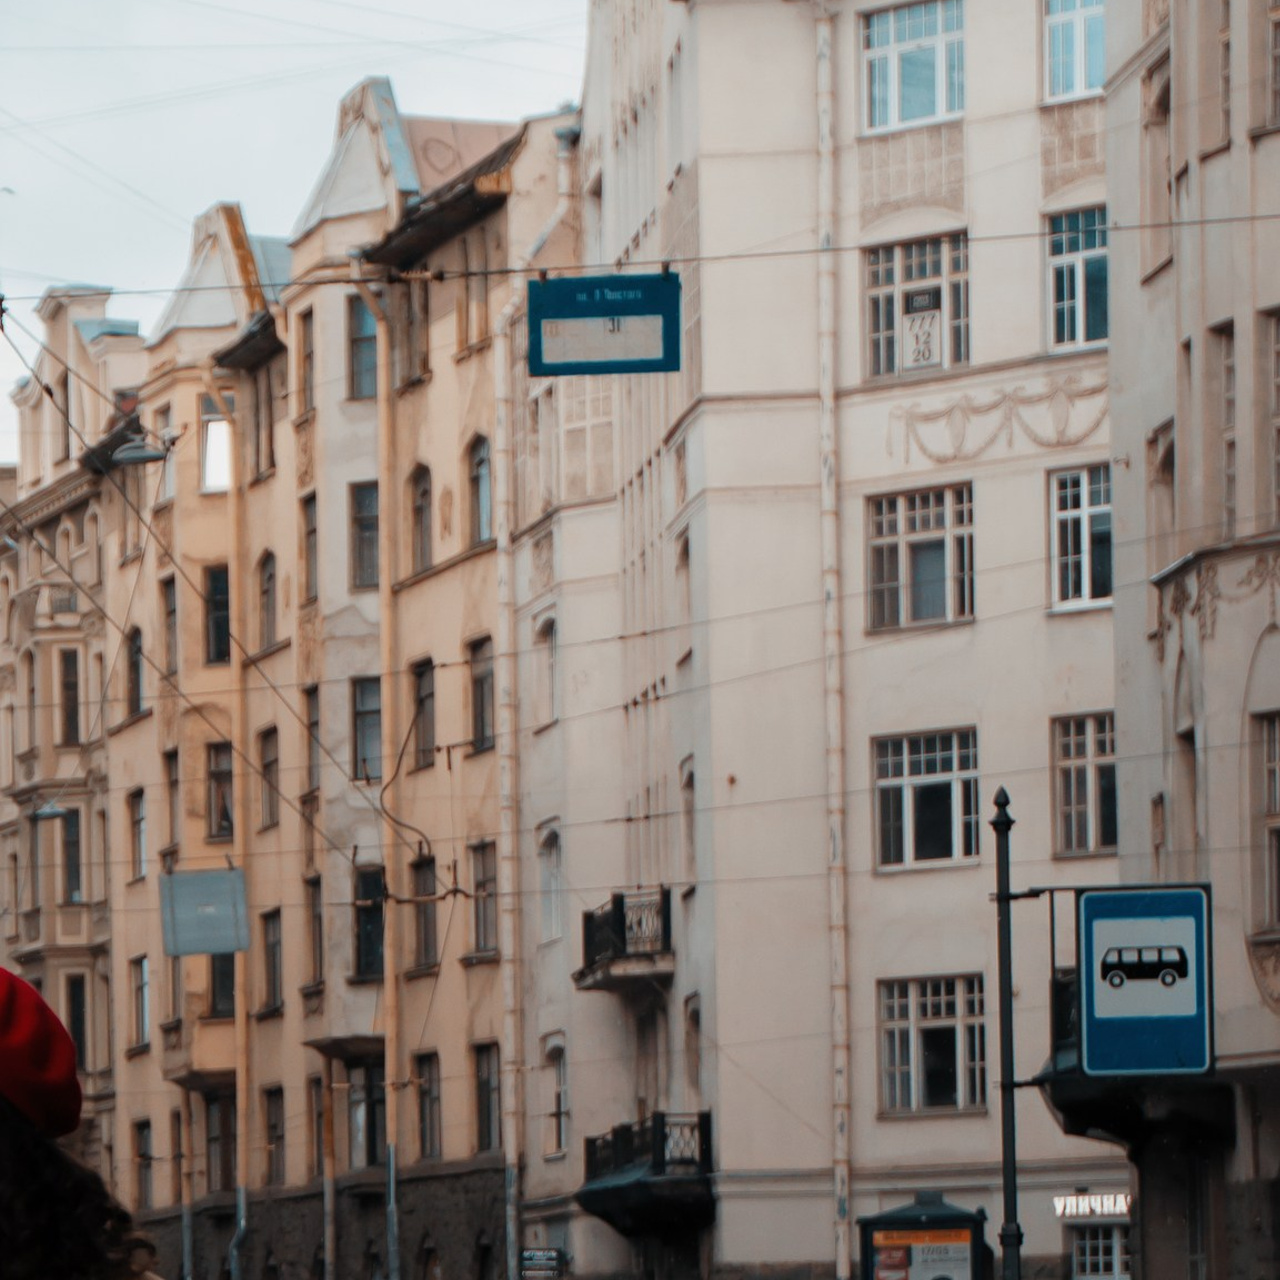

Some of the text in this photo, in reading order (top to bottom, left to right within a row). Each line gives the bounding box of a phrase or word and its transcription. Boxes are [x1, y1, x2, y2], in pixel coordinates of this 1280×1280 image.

[908, 313, 935, 331] 777
[914, 331, 931, 346] 12
[913, 348, 931, 362] 20
[1053, 1194, 1131, 1216] УЛИЧНА
